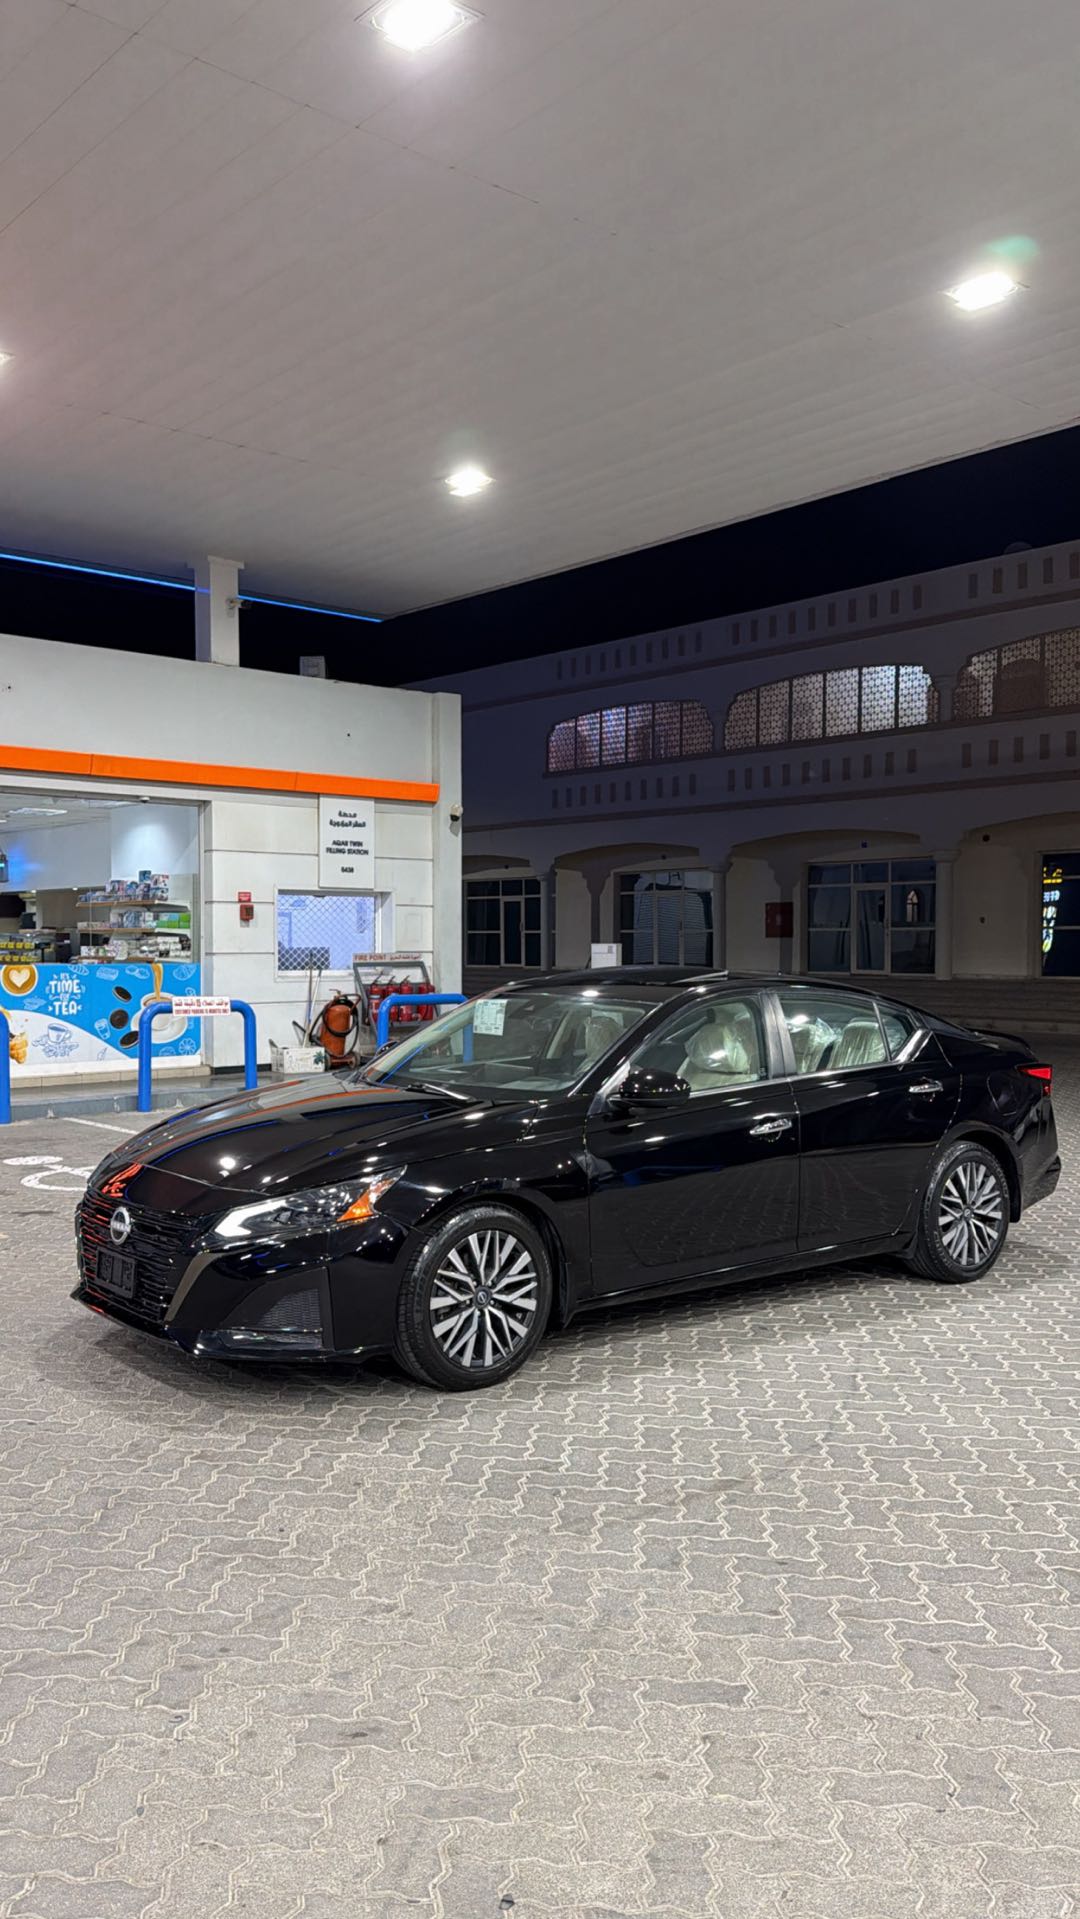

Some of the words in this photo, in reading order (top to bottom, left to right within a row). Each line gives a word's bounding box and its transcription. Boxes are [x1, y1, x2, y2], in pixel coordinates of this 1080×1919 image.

[349, 840, 363, 848] TWIN
[326, 847, 346, 855] FILLING
[347, 848, 369, 856] STATION
[49, 979, 81, 994] TIME
[53, 1001, 77, 1015] TEA
